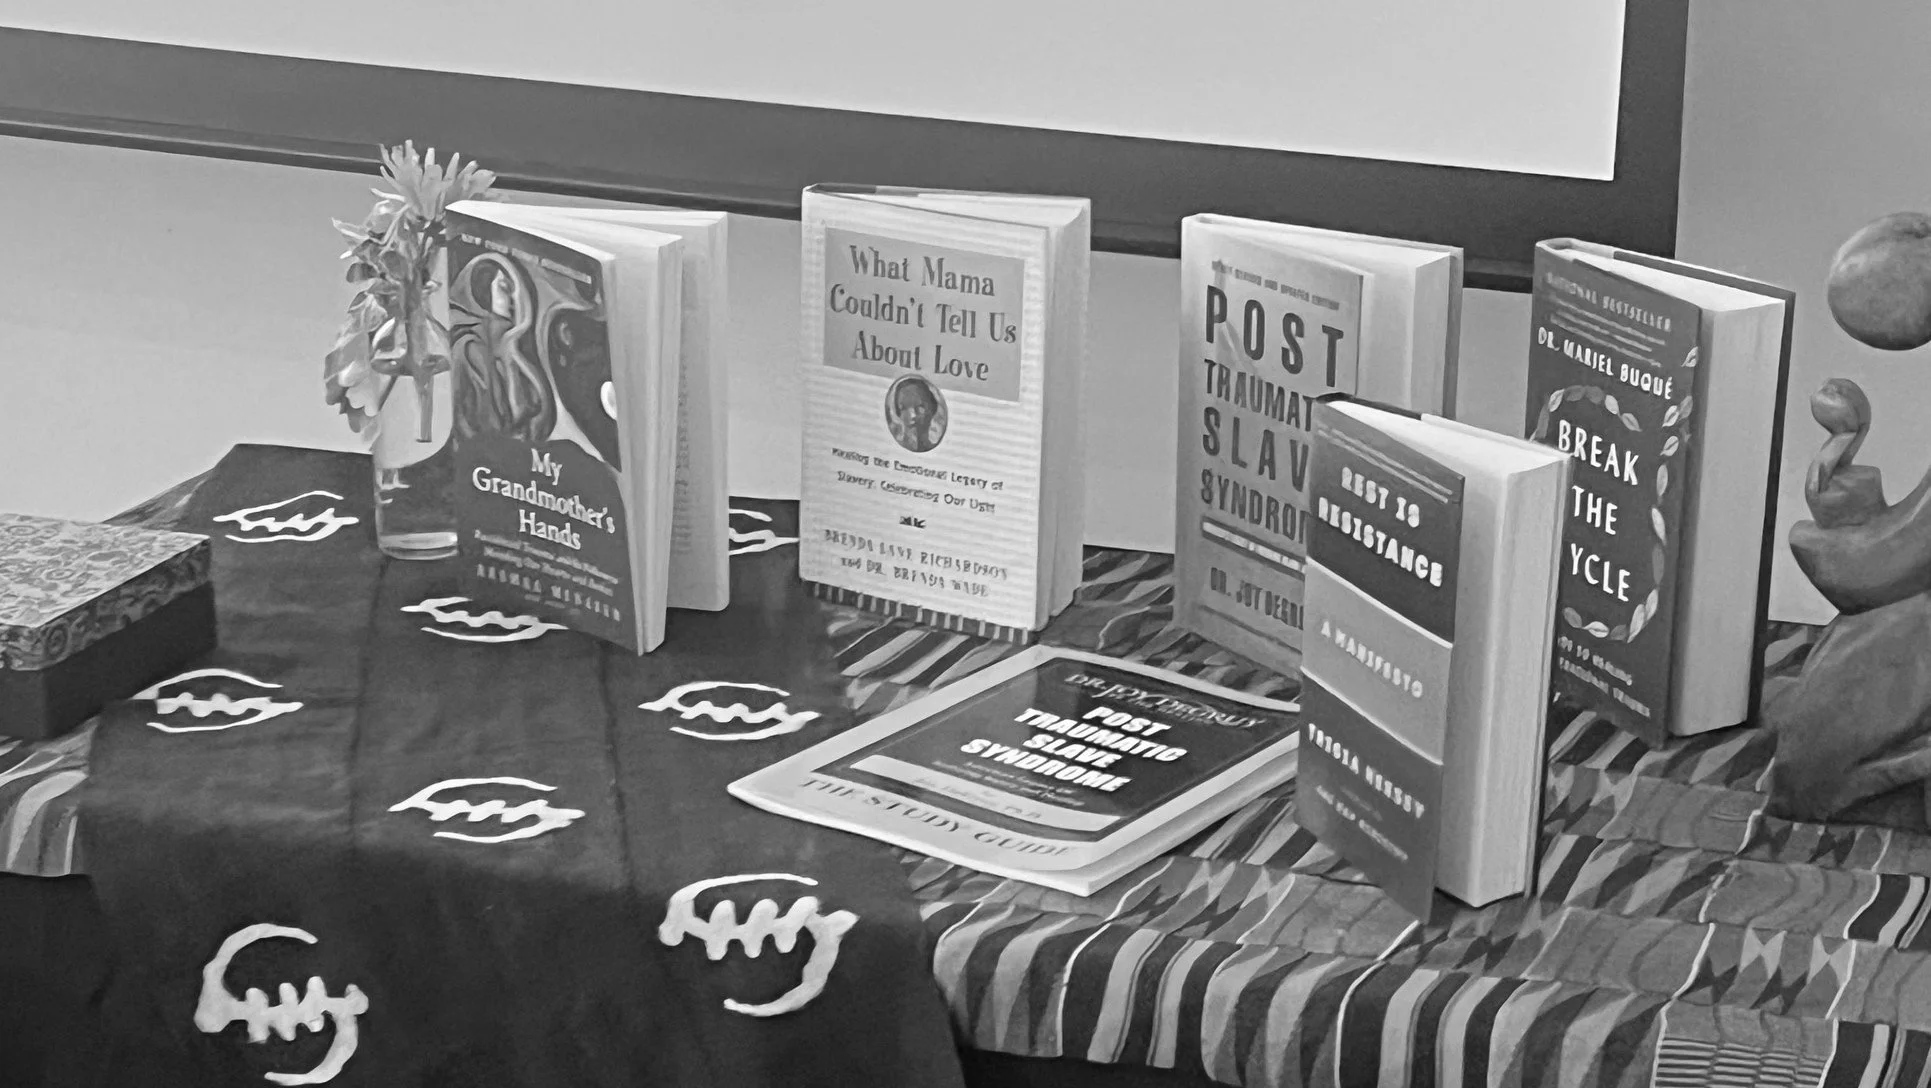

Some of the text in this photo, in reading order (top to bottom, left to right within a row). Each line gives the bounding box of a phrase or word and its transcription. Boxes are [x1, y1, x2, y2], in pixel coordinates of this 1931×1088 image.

[850, 244, 995, 296] What Mama
[830, 283, 1017, 344] Couldn't Tell Us
[1206, 284, 1344, 388] POST
[852, 330, 989, 381] About Love
[1563, 338, 1614, 376] MARIEL
[1620, 363, 1673, 400] BUQUÉ
[1204, 358, 1315, 432] TRAUMAT
[531, 447, 562, 485] My
[1203, 406, 1309, 492] SLAV
[1558, 419, 1639, 486] BREAK
[472, 466, 615, 534] Grandmother's
[1201, 468, 1306, 544] SYNDRO
[1395, 496, 1420, 528] IS
[1572, 485, 1618, 535] THE
[518, 509, 581, 550] Hands
[1318, 496, 1443, 587] RESISTANCE
[1570, 543, 1631, 602] YCLE
[1321, 620, 1331, 638] A
[1013, 708, 1188, 762] TRAUMATIC
[1082, 706, 1172, 737] POST
[960, 738, 1133, 792] SYNDROME
[1022, 733, 1122, 768] SLAVE
[864, 796, 968, 833] STUDY
[974, 831, 1072, 857] GUIDE
